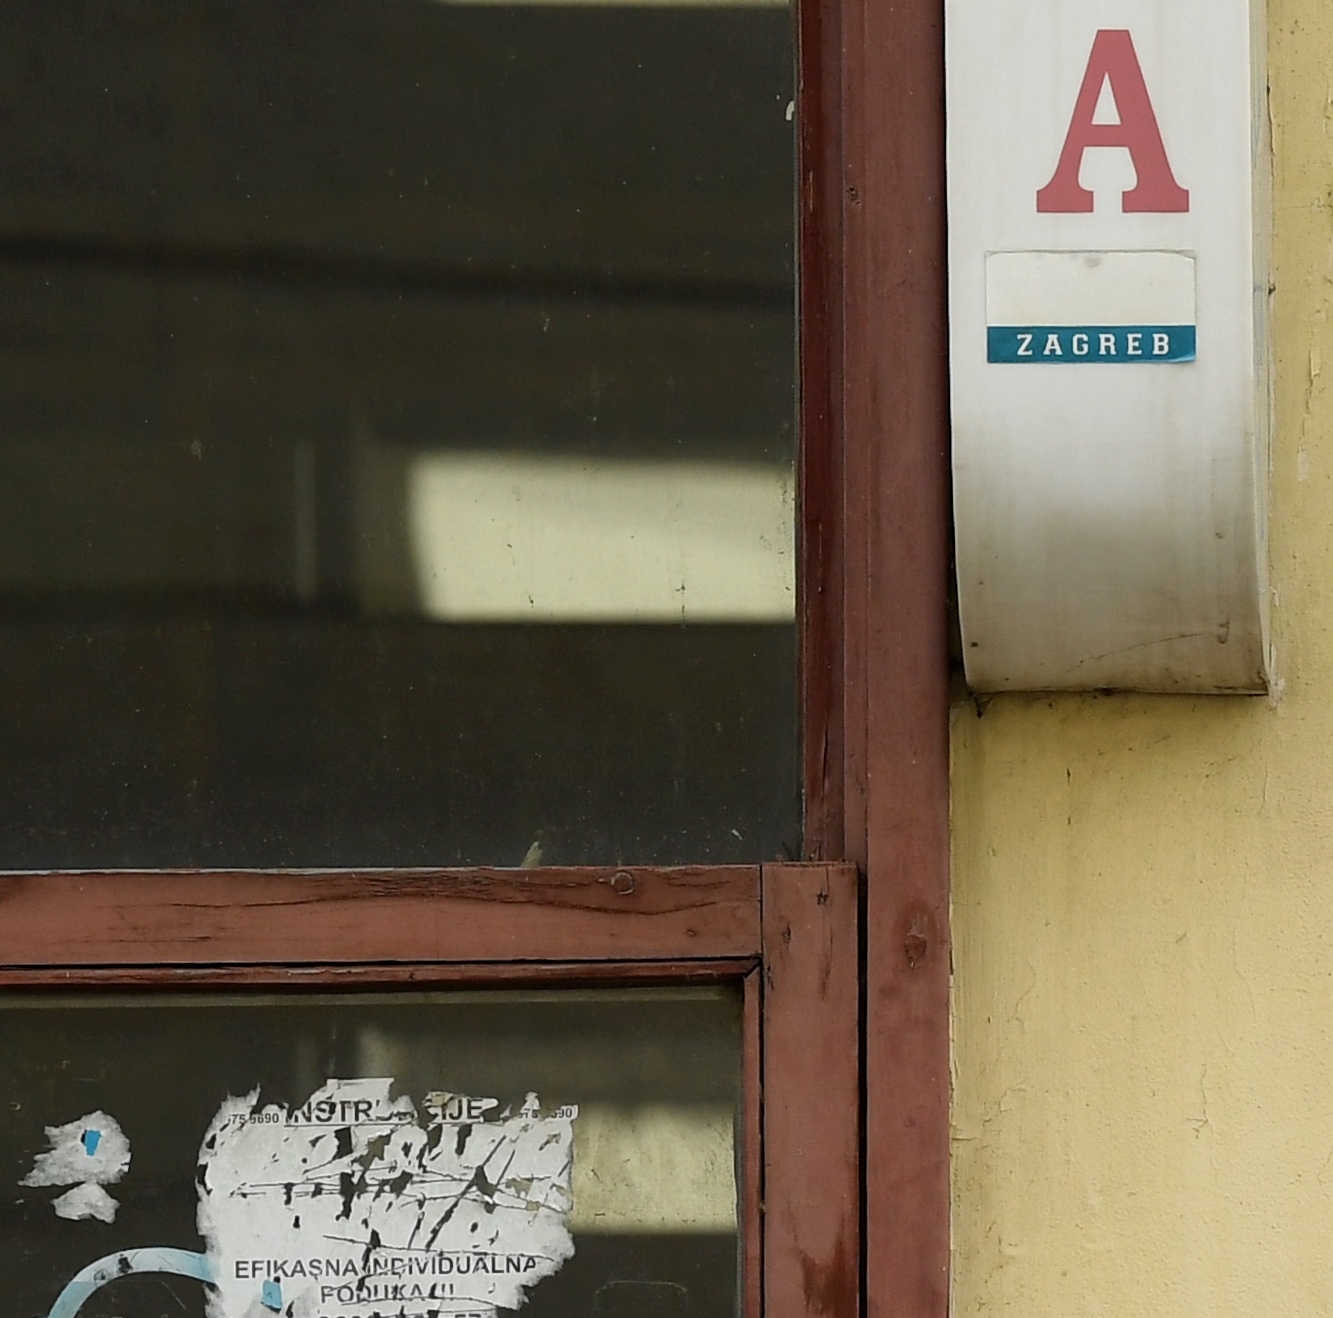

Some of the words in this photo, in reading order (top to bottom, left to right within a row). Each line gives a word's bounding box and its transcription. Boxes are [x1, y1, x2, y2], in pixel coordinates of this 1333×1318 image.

[1036, 29, 1190, 213] A
[1017, 333, 1170, 356] ZAGREB
[235, 1259, 358, 1279] EFIKASNA
